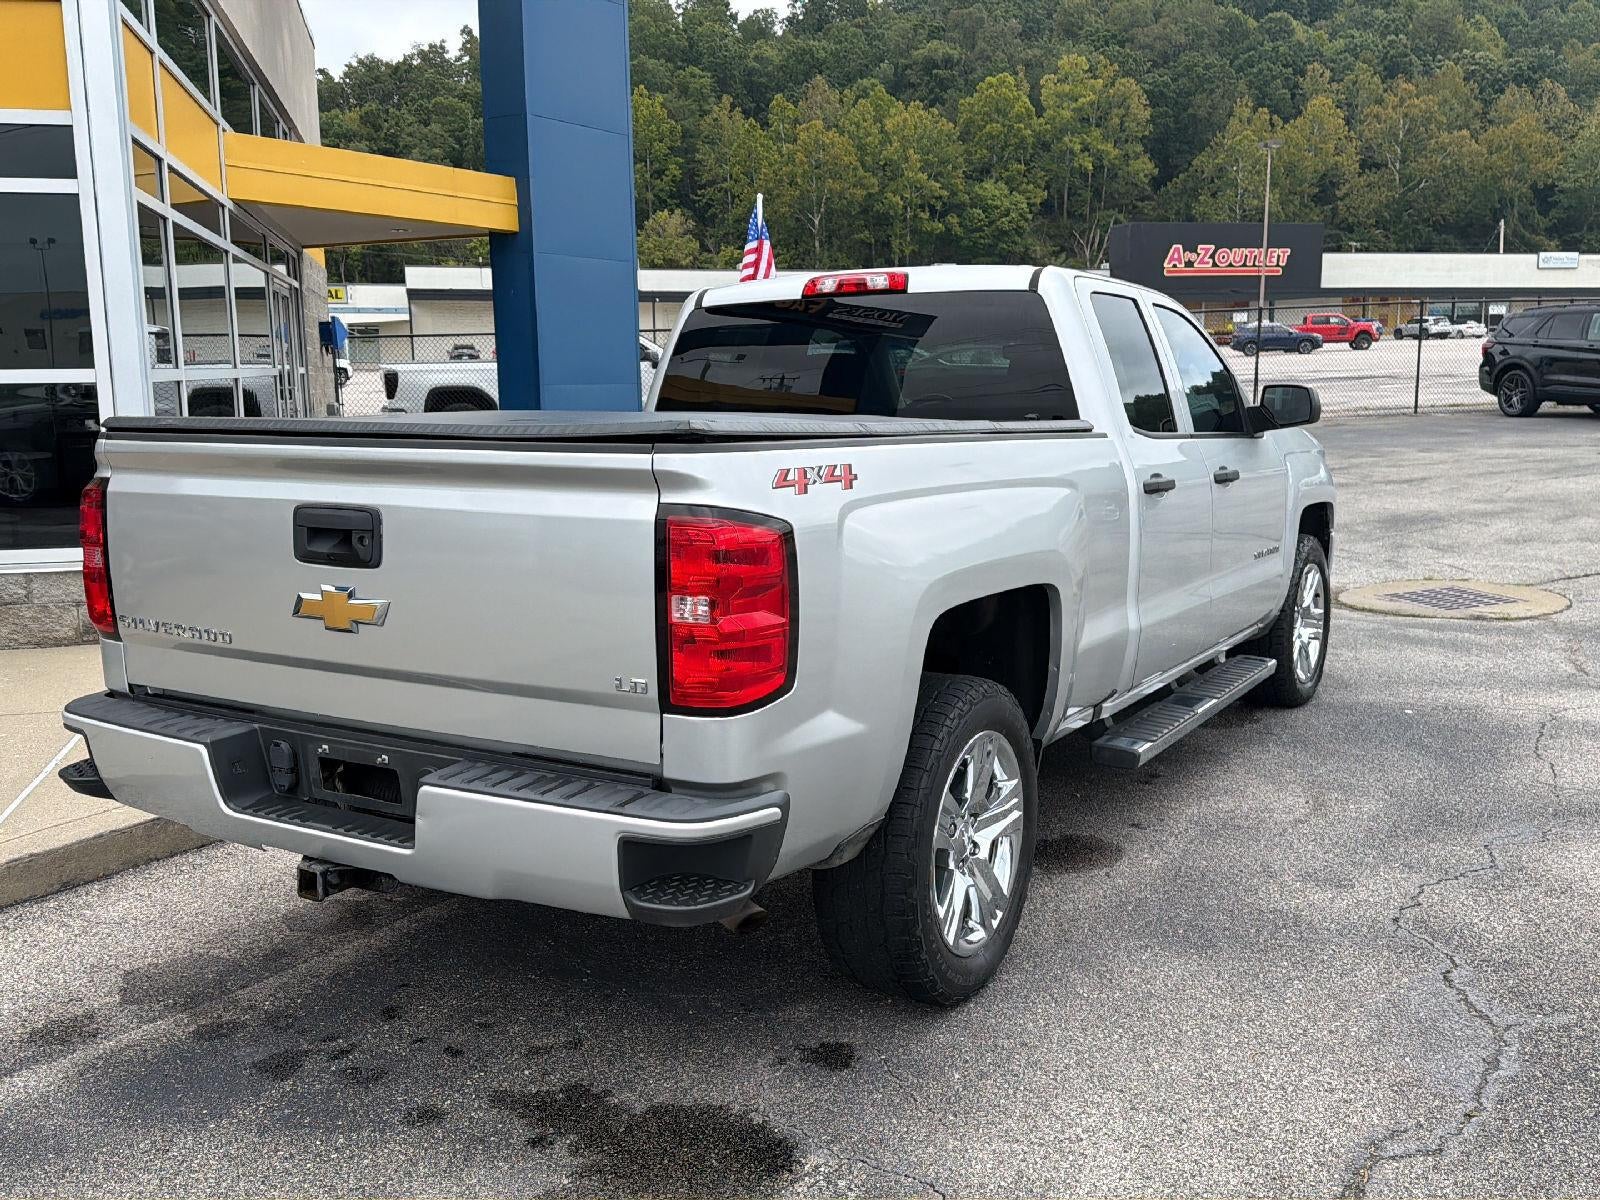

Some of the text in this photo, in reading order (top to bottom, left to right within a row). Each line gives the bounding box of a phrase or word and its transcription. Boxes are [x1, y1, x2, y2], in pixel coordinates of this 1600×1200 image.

[1215, 247, 1291, 267] OUTLET
[119, 614, 233, 645] SILVERADO
[615, 676, 648, 695] LD
